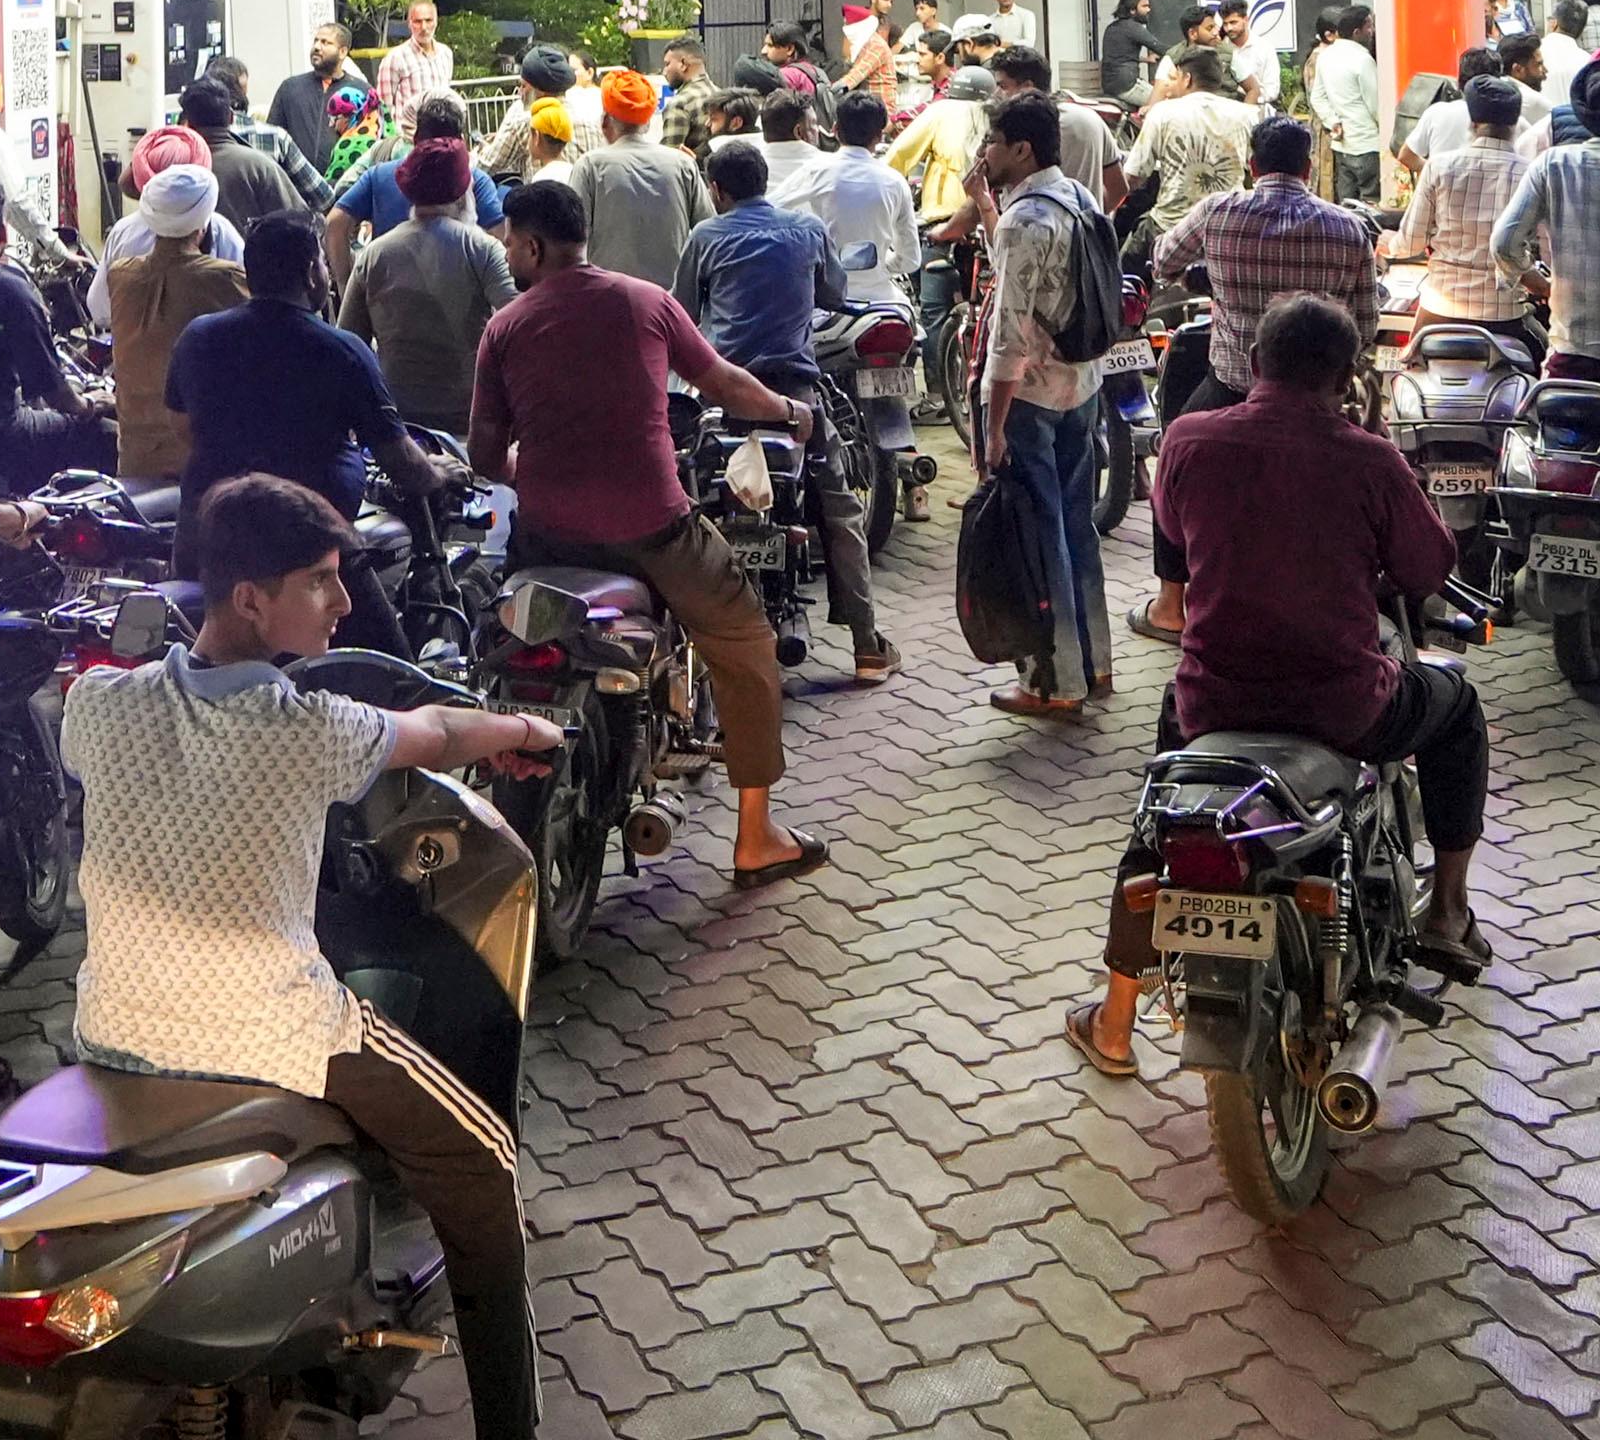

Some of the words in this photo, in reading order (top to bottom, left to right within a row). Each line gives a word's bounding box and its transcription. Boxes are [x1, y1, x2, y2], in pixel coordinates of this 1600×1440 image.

[1105, 354, 1148, 370] 3095
[1433, 478, 1487, 492] 6590
[734, 550, 778, 565] 788
[1535, 553, 1599, 576] 7315
[1180, 896, 1252, 915] PB02BH
